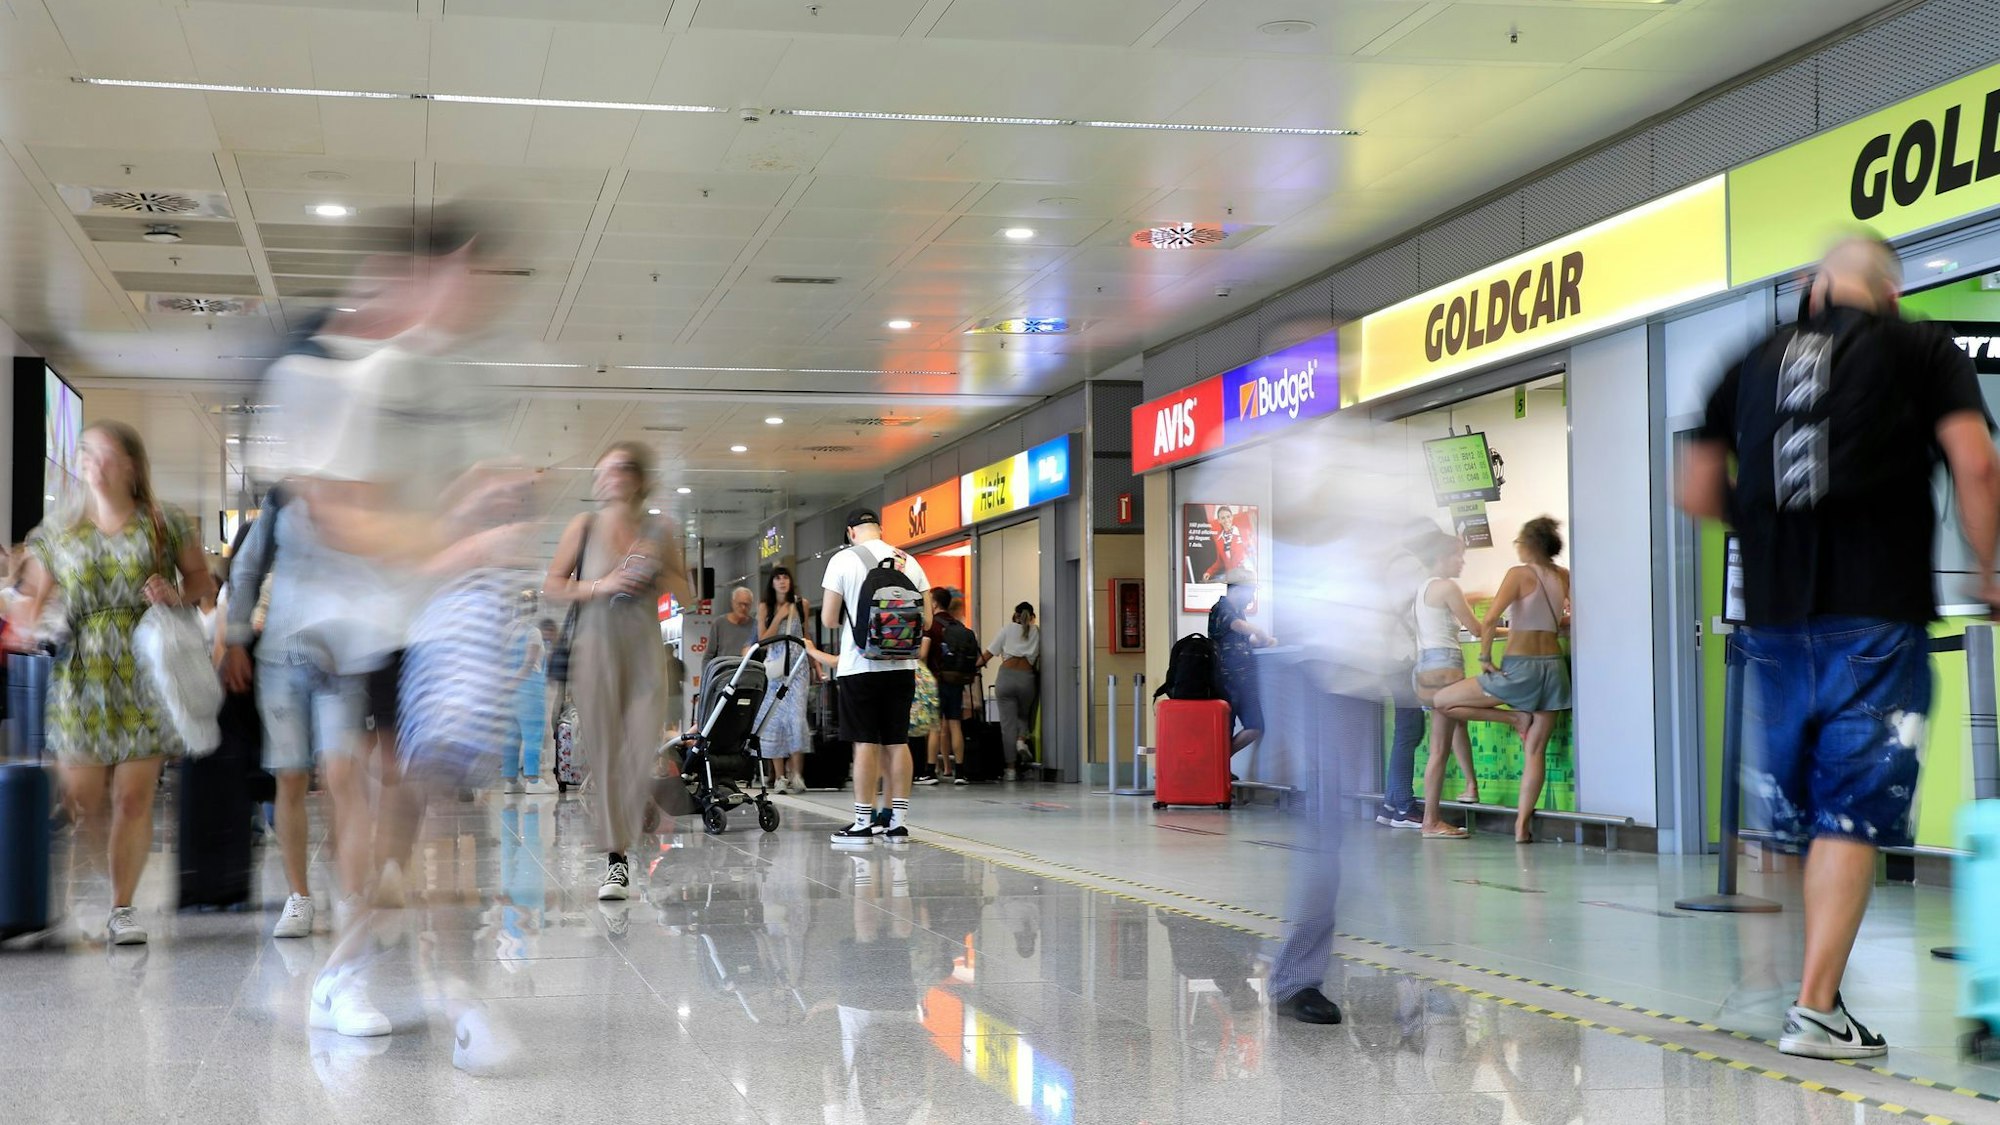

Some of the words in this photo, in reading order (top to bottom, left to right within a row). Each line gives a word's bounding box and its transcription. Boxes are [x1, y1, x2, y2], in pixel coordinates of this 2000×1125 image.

[1425, 251, 1584, 362] GOLDCAR
[1259, 360, 1315, 419] Budget
[1153, 398, 1196, 457] AVIS
[980, 472, 1006, 512] Hertz
